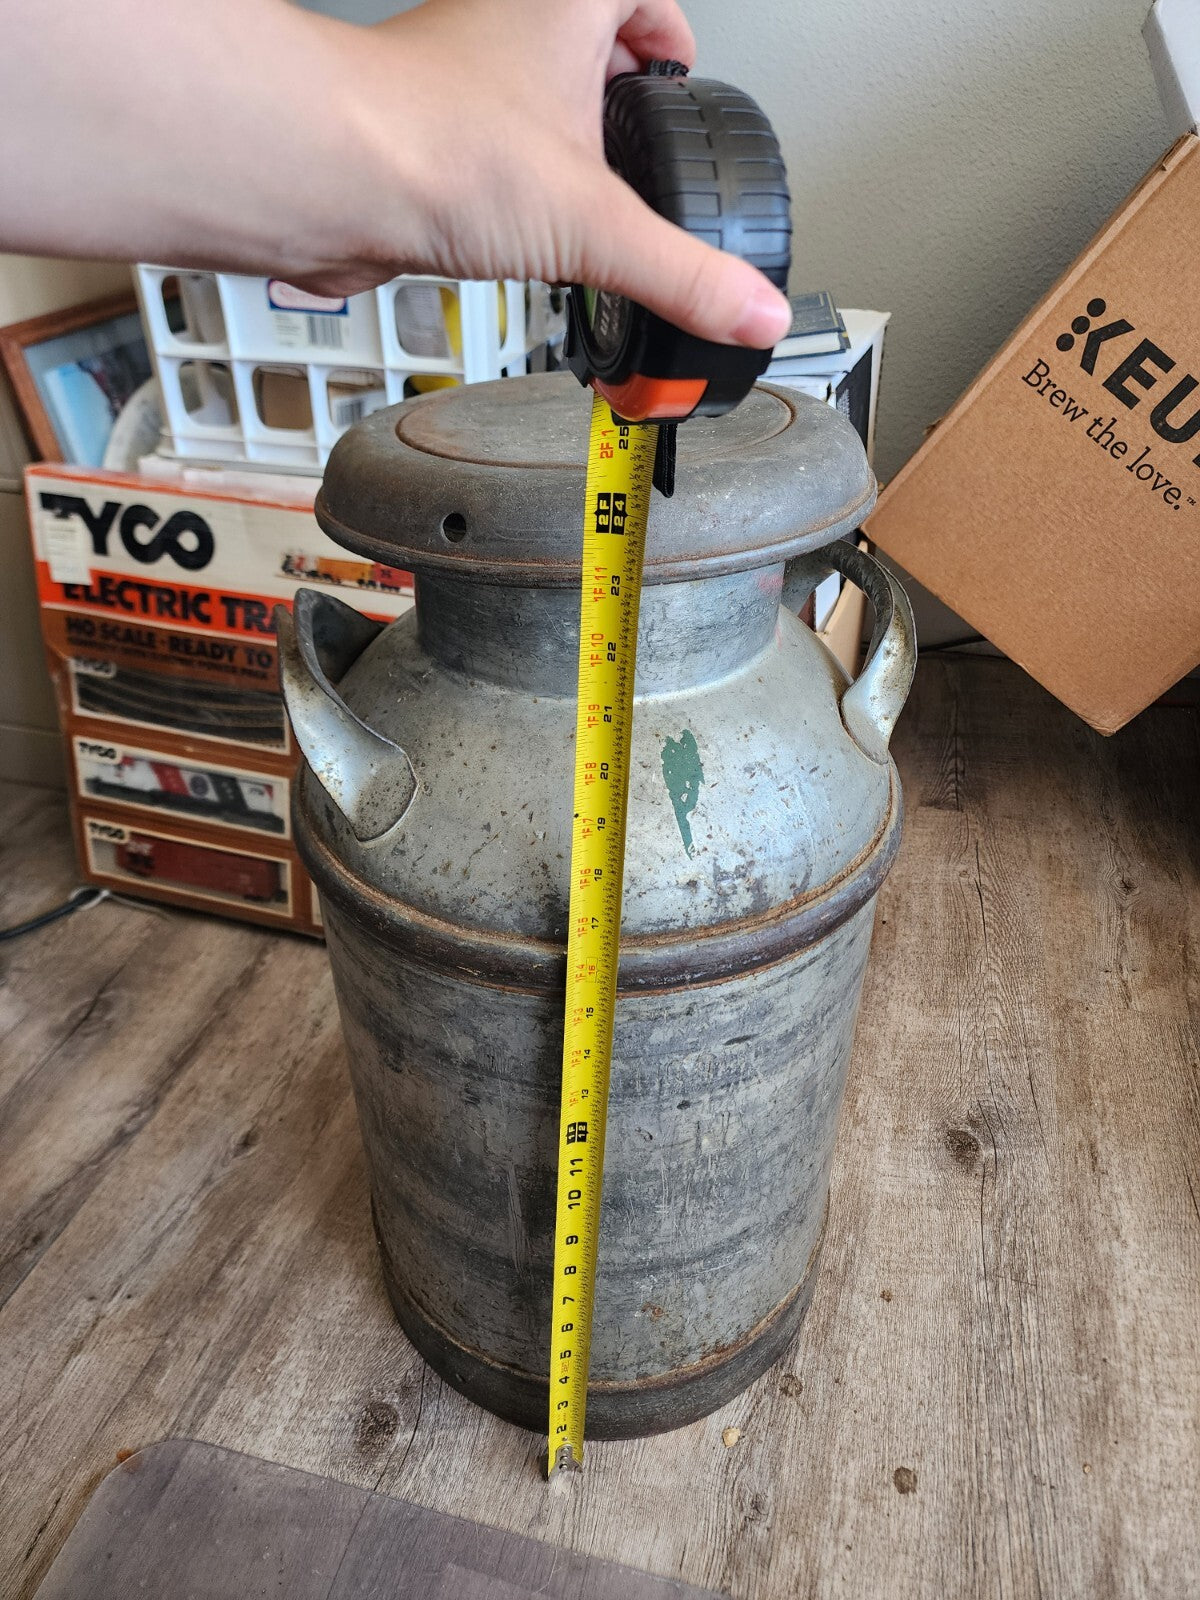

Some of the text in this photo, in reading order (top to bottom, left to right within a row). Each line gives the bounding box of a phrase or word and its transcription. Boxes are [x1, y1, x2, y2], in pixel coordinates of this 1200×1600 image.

[1056, 298, 1200, 468] KEU
[1021, 358, 1088, 422] Brew
[1086, 417, 1128, 459] the
[619, 426, 630, 450] 25
[600, 442, 614, 459] 2F
[598, 499, 610, 526] 2F
[613, 500, 626, 527] 24
[610, 575, 621, 597] 23
[66, 616, 96, 638] HO
[101, 622, 156, 649] SCALE
[169, 636, 236, 662] READY
[246, 645, 273, 668] TO
[607, 642, 616, 662] 22
[603, 705, 613, 723] 21
[600, 762, 609, 780] 20
[597, 817, 606, 831] 19
[594, 868, 602, 882] 18
[591, 917, 599, 930] 17
[588, 965, 595, 975] 16
[586, 1007, 594, 1018] 15
[584, 1049, 591, 1059] 14
[581, 1089, 589, 1099] 13
[578, 1125, 586, 1139] 12
[570, 1158, 583, 1176] 11
[568, 1189, 581, 1210] 10
[566, 1235, 578, 1245] 9
[564, 1266, 576, 1275] 8
[563, 1296, 574, 1305] 7
[561, 1323, 573, 1332] 6
[560, 1350, 571, 1359] 5
[559, 1375, 570, 1384] 4
[557, 1400, 568, 1410] 3
[556, 1424, 567, 1434] 2
